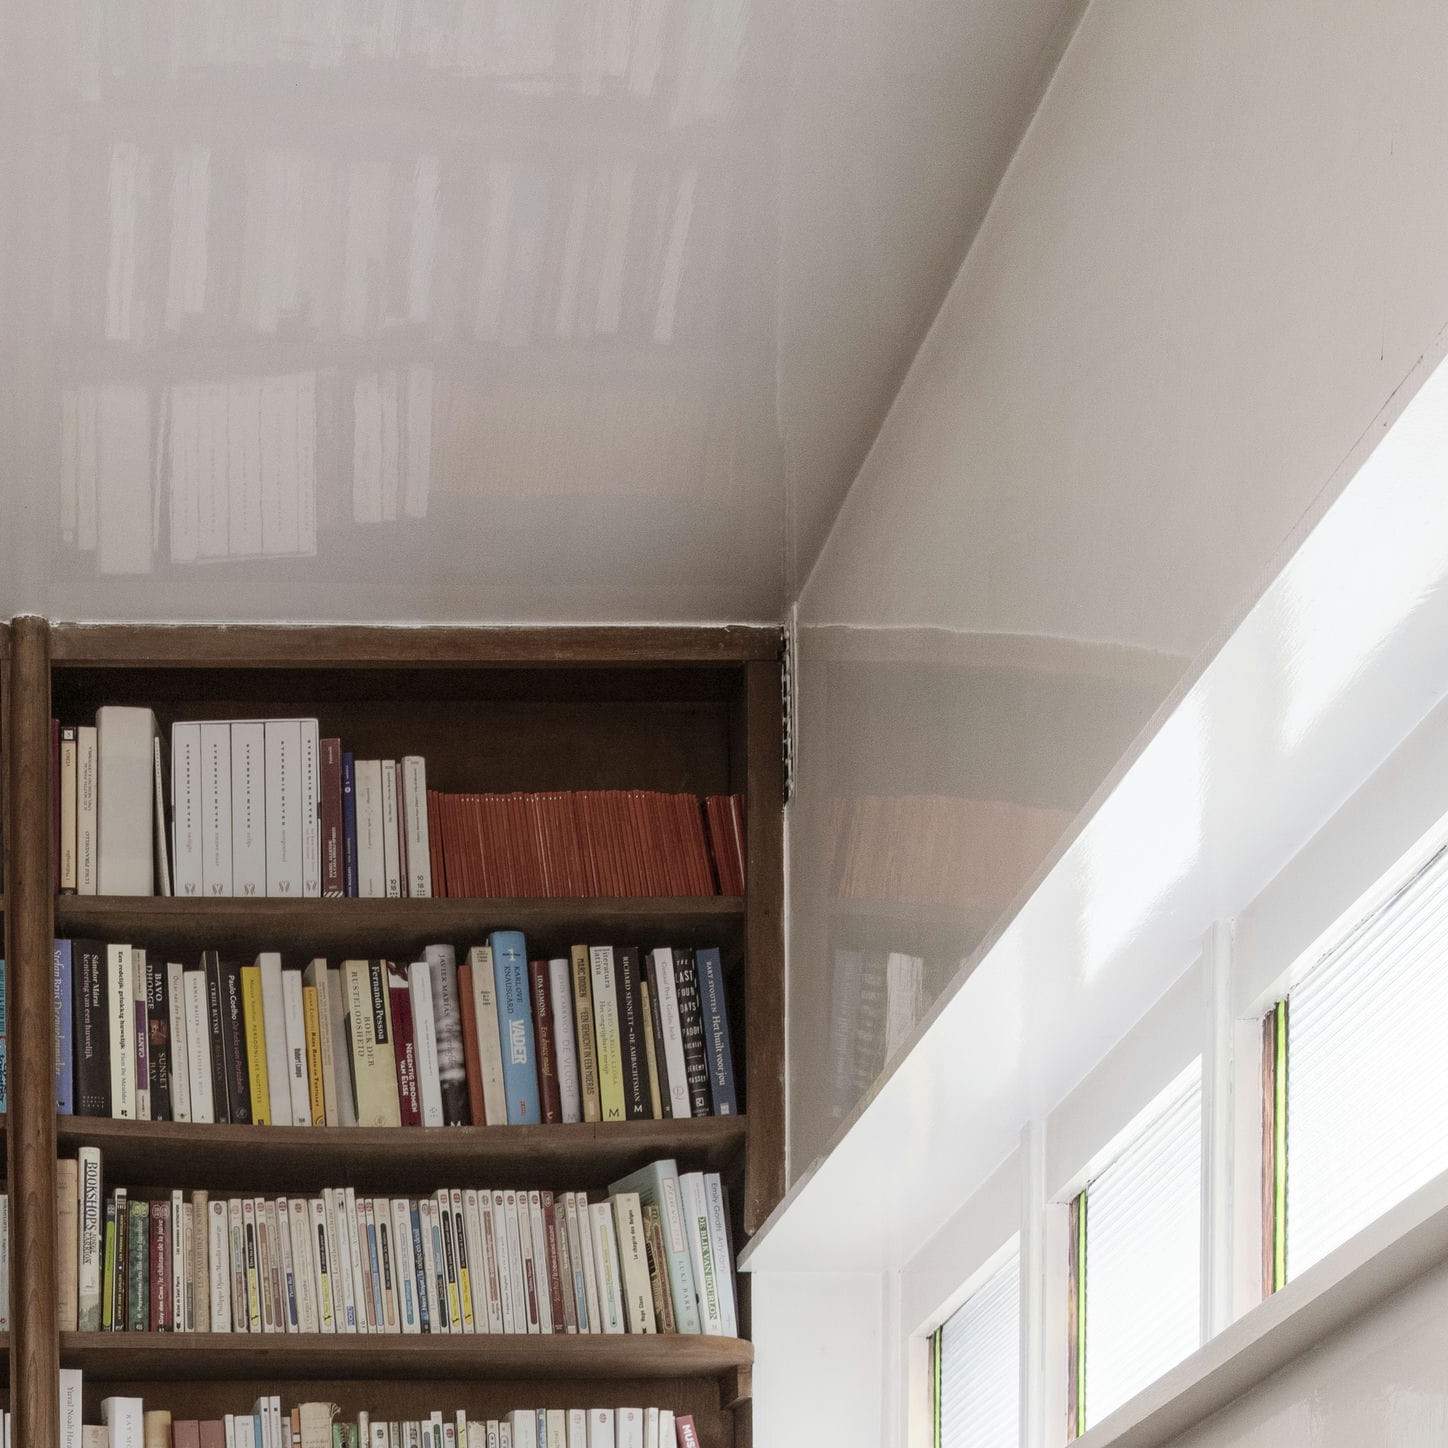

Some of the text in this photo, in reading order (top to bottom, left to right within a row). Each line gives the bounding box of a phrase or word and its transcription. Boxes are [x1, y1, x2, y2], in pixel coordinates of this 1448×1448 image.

[91, 954, 99, 983] Sándor
[438, 954, 447, 983] JAVIER
[514, 966, 522, 983] KARL
[154, 973, 163, 1002] BAVO
[228, 975, 239, 1020] Paulo Coelho
[371, 966, 386, 1040] Fernando Pessoa
[537, 989, 546, 1017] SIMONS
[351, 971, 365, 1057] RUSTELOOSHEID
[621, 956, 640, 1102] RICHARD SENNETT DE AMBACHTSMAN
[706, 961, 727, 1086] BART STOUTEN Het huilt voor jou
[84, 1024, 92, 1059] huwelijk
[363, 1016, 375, 1067] BOEK DER
[511, 1019, 527, 1065] VADER
[158, 1052, 167, 1090] SUNSET
[401, 1076, 409, 1096] ELISE
[405, 1042, 418, 1113] NEGENTIG DROMEN
[87, 1162, 98, 1232] BOOKSHOPS
[710, 1182, 719, 1203] Emily
[699, 1230, 708, 1253] BLIK
[678, 1261, 690, 1312] LUKE BARR
[66, 1386, 74, 1407] Yuval
[67, 1409, 75, 1429] Noah
